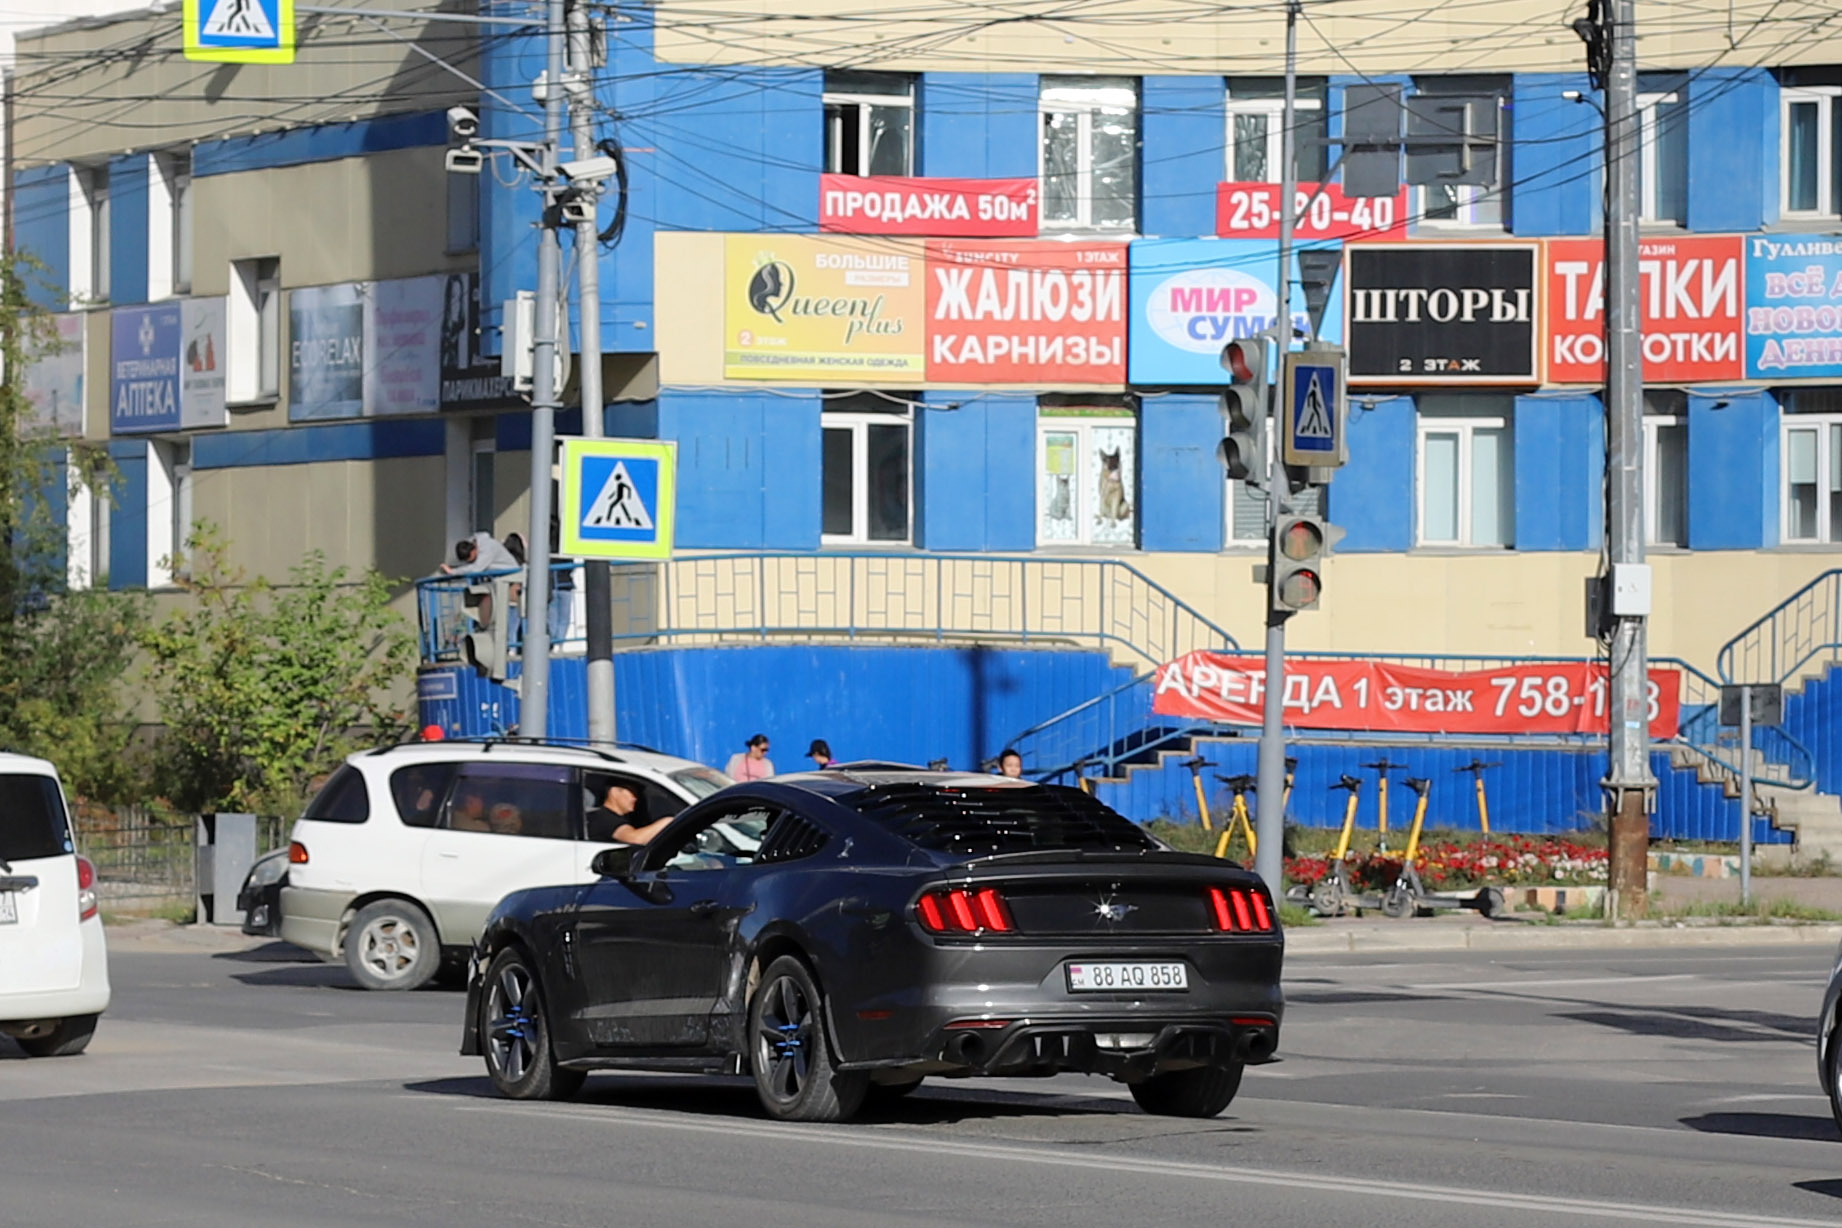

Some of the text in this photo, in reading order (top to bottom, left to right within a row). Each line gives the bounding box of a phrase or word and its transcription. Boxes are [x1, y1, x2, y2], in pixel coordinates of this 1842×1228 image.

[826, 190, 970, 222] ПРОДАЖА
[815, 254, 910, 269] БОЛЬШИЕ
[747, 262, 873, 324] Queen
[934, 268, 1121, 322] ЖАЛЮЗИ
[1765, 265, 1825, 298] ВСЁ
[1170, 287, 1257, 313] МИР
[1352, 289, 1531, 322] ШТОРЫ
[844, 295, 903, 345] plus
[1748, 305, 1842, 334] НОВО
[740, 333, 751, 346] 2
[933, 334, 1121, 365] КАРНИЗЫ
[1554, 332, 1737, 364] КООТКИ
[1399, 359, 1480, 371] 2 ЭТАЖ
[117, 379, 176, 418] АПТЕКА
[1353, 677, 1368, 709] 1
[1384, 687, 1474, 712] этаж
[1093, 965, 1182, 986] 88 AQ 858
